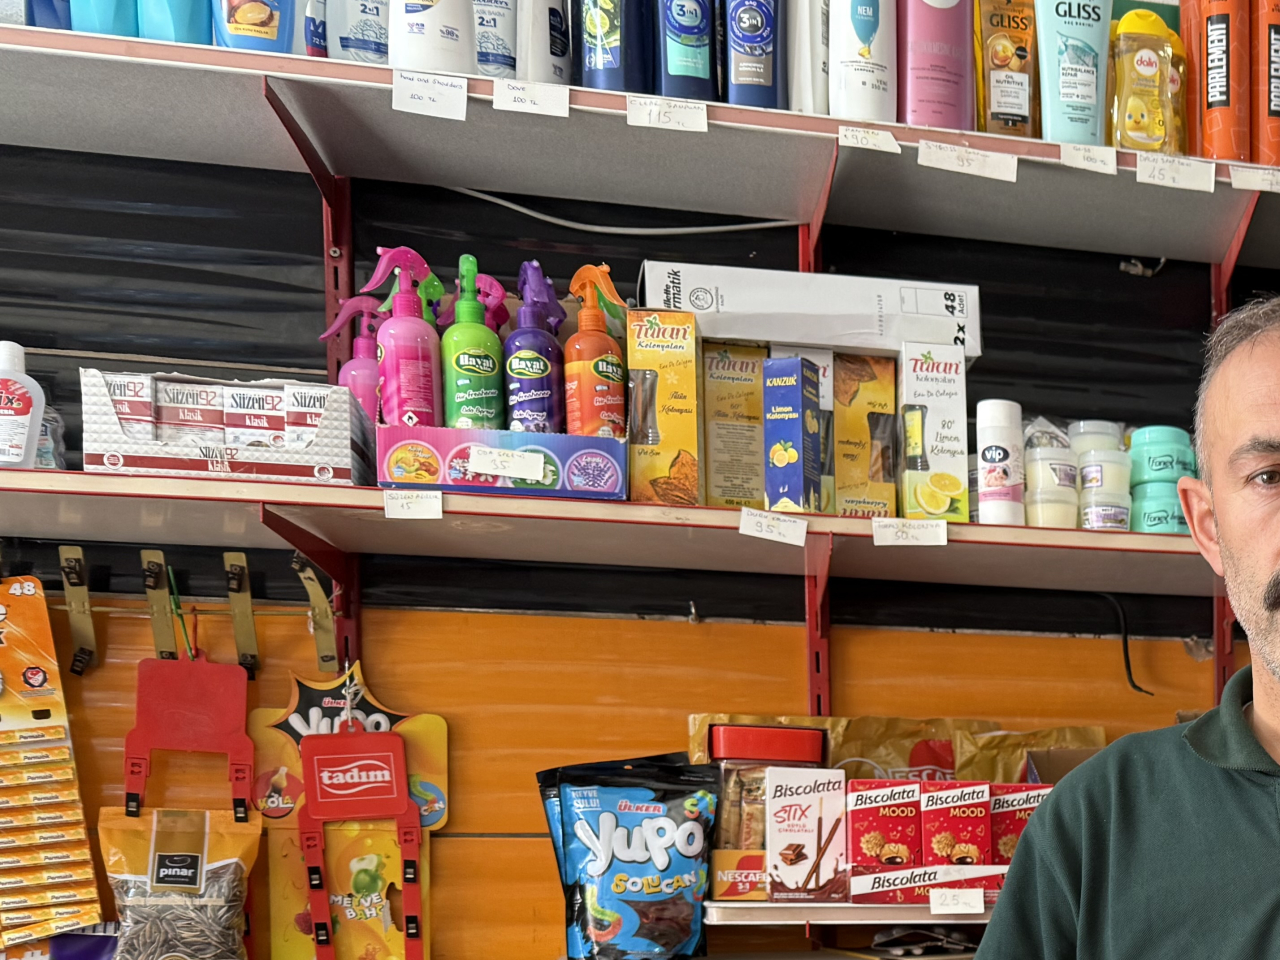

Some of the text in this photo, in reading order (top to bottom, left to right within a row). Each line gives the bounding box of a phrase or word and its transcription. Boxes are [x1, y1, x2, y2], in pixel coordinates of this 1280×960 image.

[857, 6, 873, 16] NEM
[1055, 1, 1101, 22] GLISS
[989, 13, 1028, 30] GLISS
[1136, 56, 1158, 69] dalin
[1208, 18, 1227, 102] PARLEMENT
[1148, 166, 1165, 180] 45
[944, 292, 957, 316] 48
[633, 319, 691, 341] Turan
[459, 354, 494, 369] Hayat
[512, 358, 544, 372] Hayat
[706, 356, 760, 374] Turan
[911, 358, 961, 376] Turan
[766, 376, 798, 387] KANZUK
[179, 408, 203, 422] Klasik
[245, 414, 269, 428] Klasik
[984, 448, 1004, 463] vip
[8, 582, 36, 596] 48
[321, 768, 392, 784] tadım
[772, 778, 842, 799] Biscolata
[854, 788, 917, 808] Biscolata
[925, 788, 986, 809] Biscolata
[618, 800, 662, 814] ÜLKER
[773, 804, 812, 824] STIX
[878, 806, 916, 818] MOOD
[950, 807, 986, 818] MOOD
[612, 870, 697, 894] SOLUCAN
[870, 870, 938, 890] Biscolata
